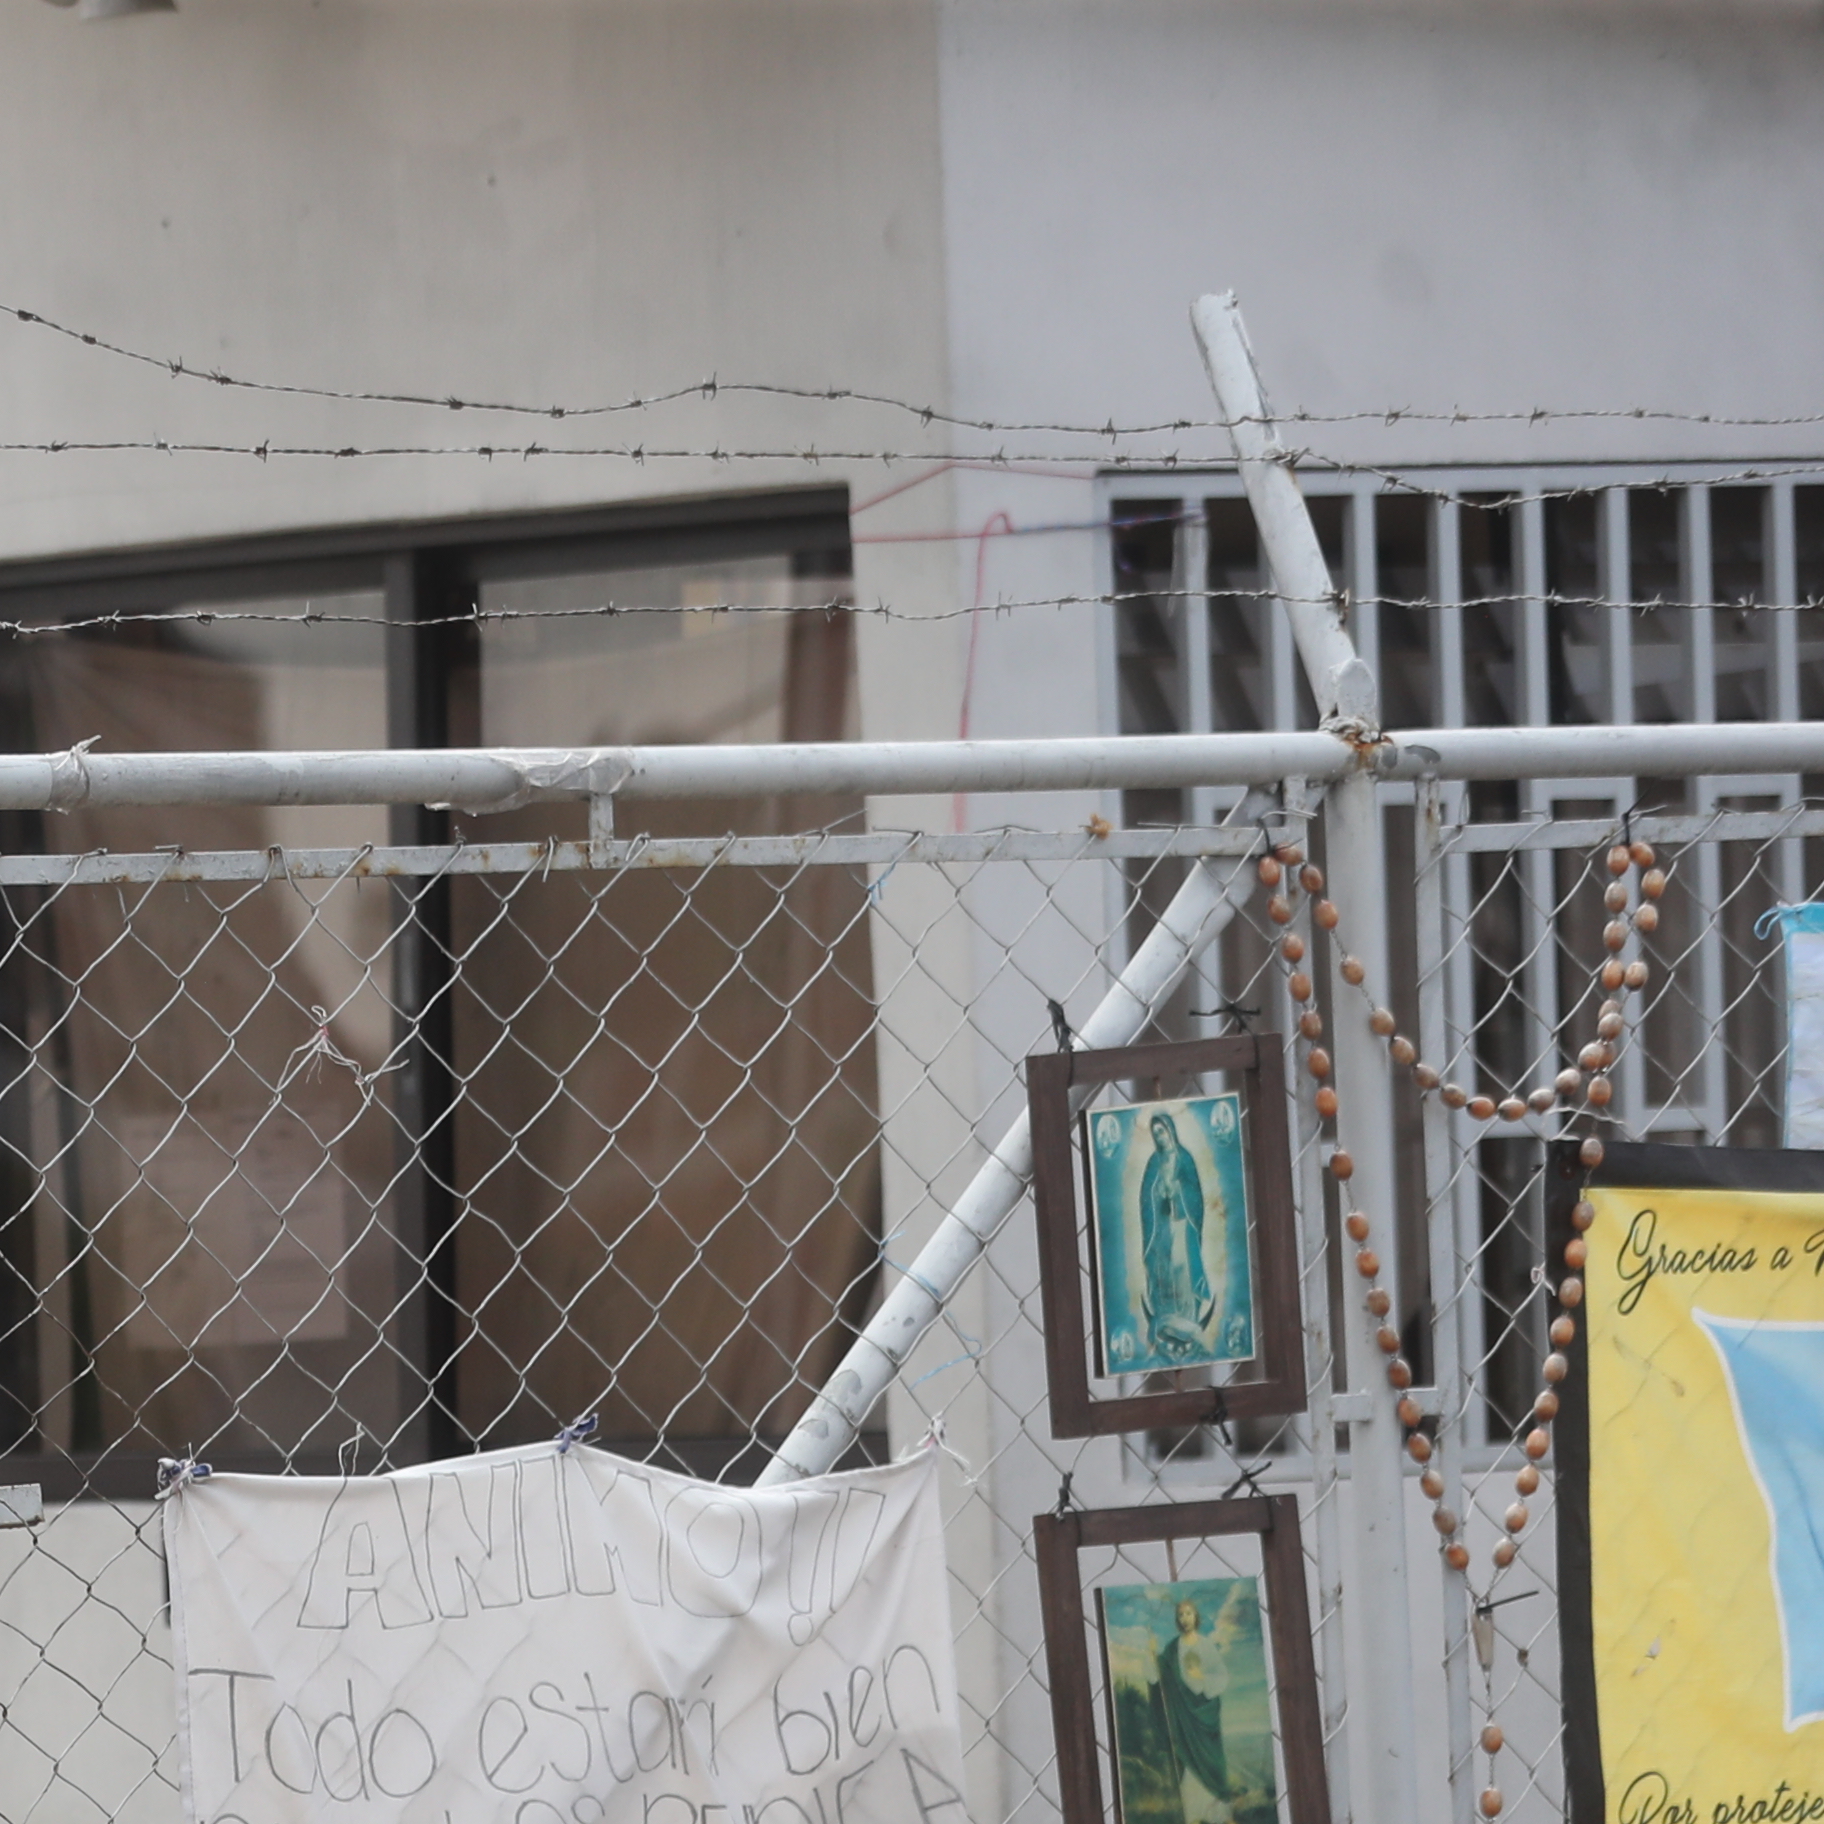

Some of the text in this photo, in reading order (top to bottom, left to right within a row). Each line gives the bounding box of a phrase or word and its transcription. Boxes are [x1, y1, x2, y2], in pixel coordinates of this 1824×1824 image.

[1617, 1209, 1758, 1315] Gracias
[1770, 1246, 1793, 1271] a
[188, 1668, 437, 1802] Todo
[774, 1645, 940, 1775] bien
